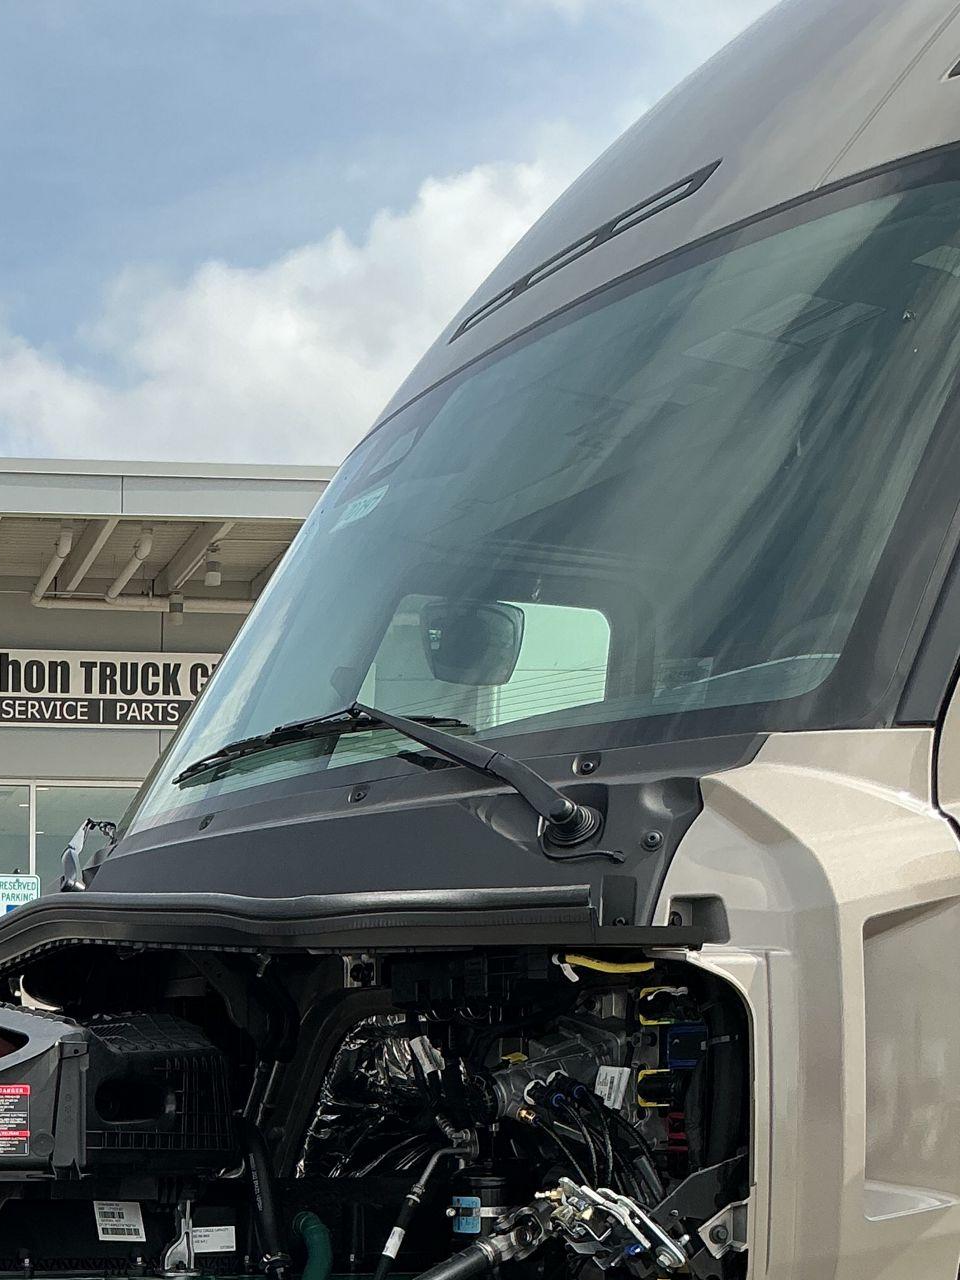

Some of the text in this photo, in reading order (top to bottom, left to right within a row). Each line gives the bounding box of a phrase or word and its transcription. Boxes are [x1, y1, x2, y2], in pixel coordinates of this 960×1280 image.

[80, 661, 182, 696] TRUCK
[190, 662, 218, 698] C
[1, 700, 89, 720] SERVICE
[116, 702, 179, 721] PARTS
[0, 881, 36, 891] RESERVED
[1, 893, 34, 902] PARKING
